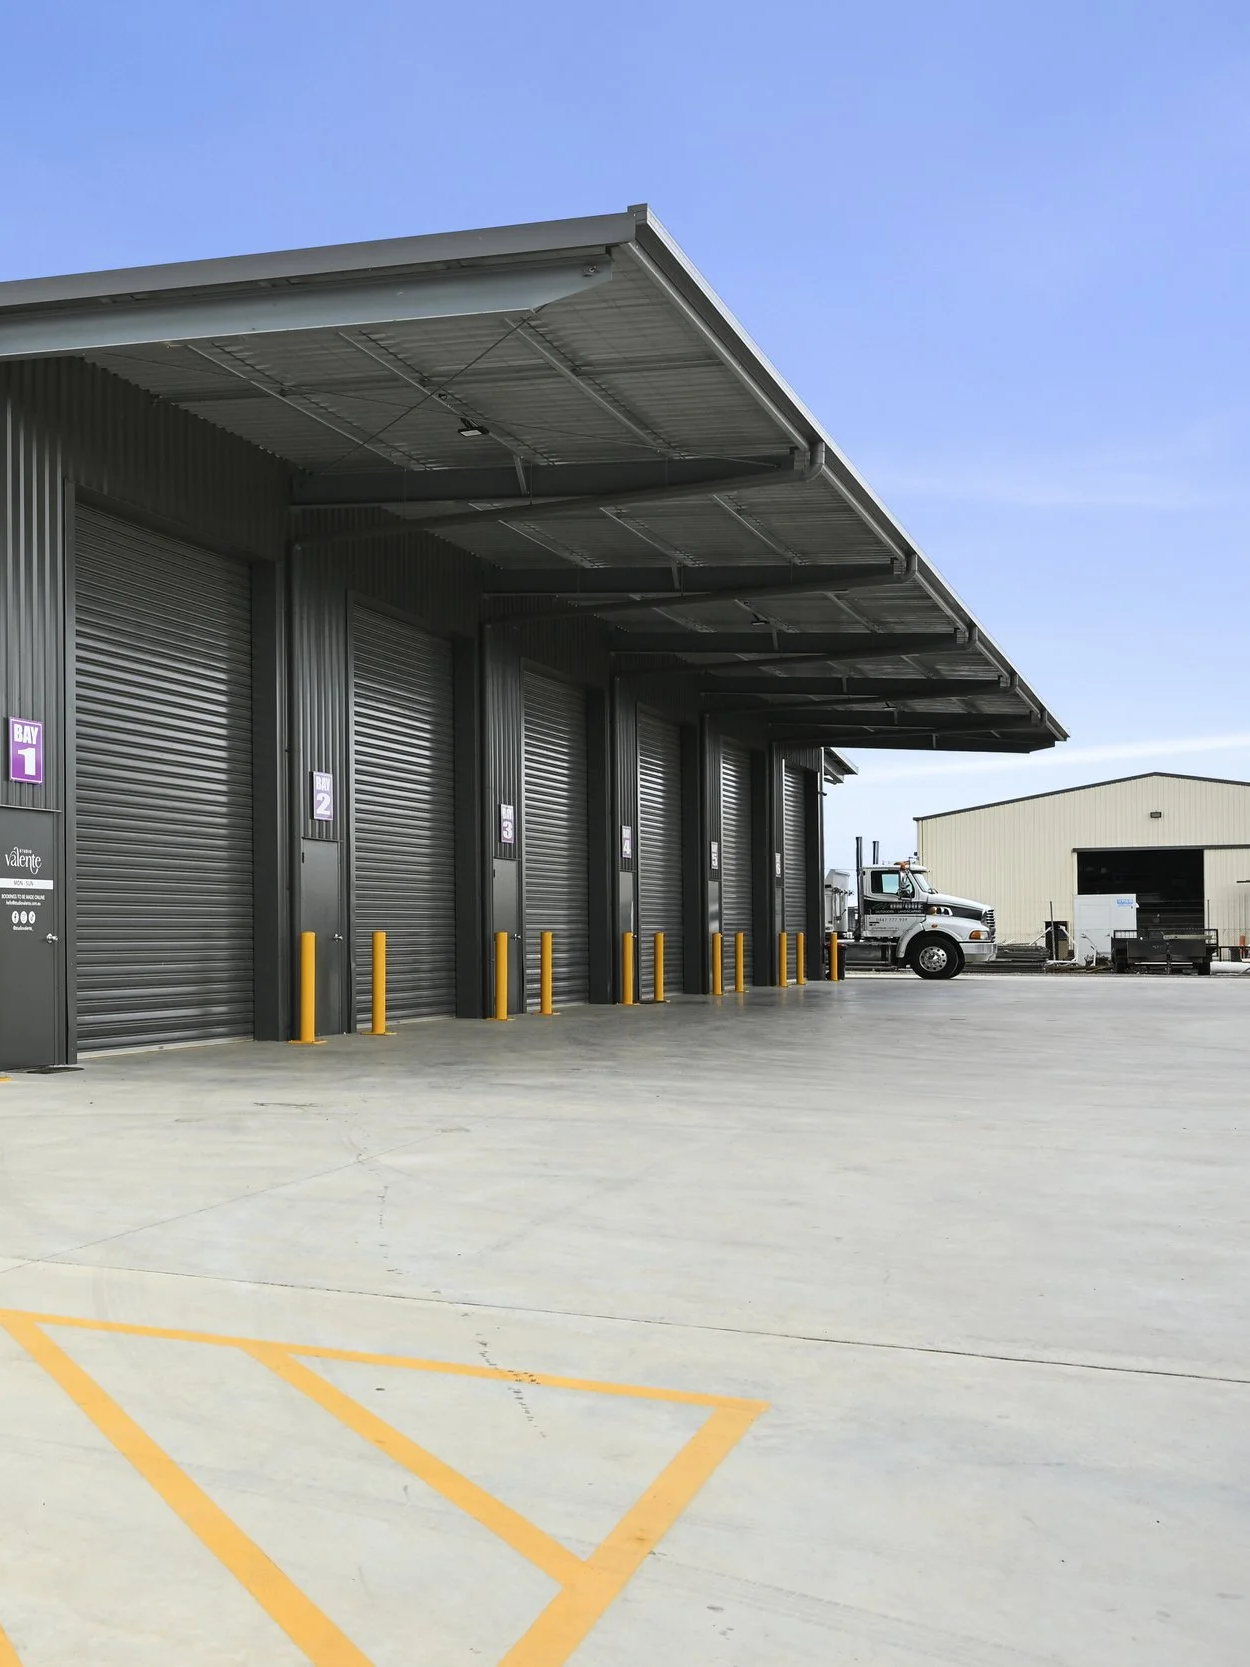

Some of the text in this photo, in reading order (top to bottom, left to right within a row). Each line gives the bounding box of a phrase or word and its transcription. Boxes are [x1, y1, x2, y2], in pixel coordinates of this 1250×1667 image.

[13, 723, 39, 745] BAY
[17, 747, 36, 776] 1
[315, 775, 331, 792] BAY
[316, 793, 331, 816] 2
[502, 821, 513, 839] 3
[623, 840, 631, 855] 4
[711, 853, 718, 866] 5
